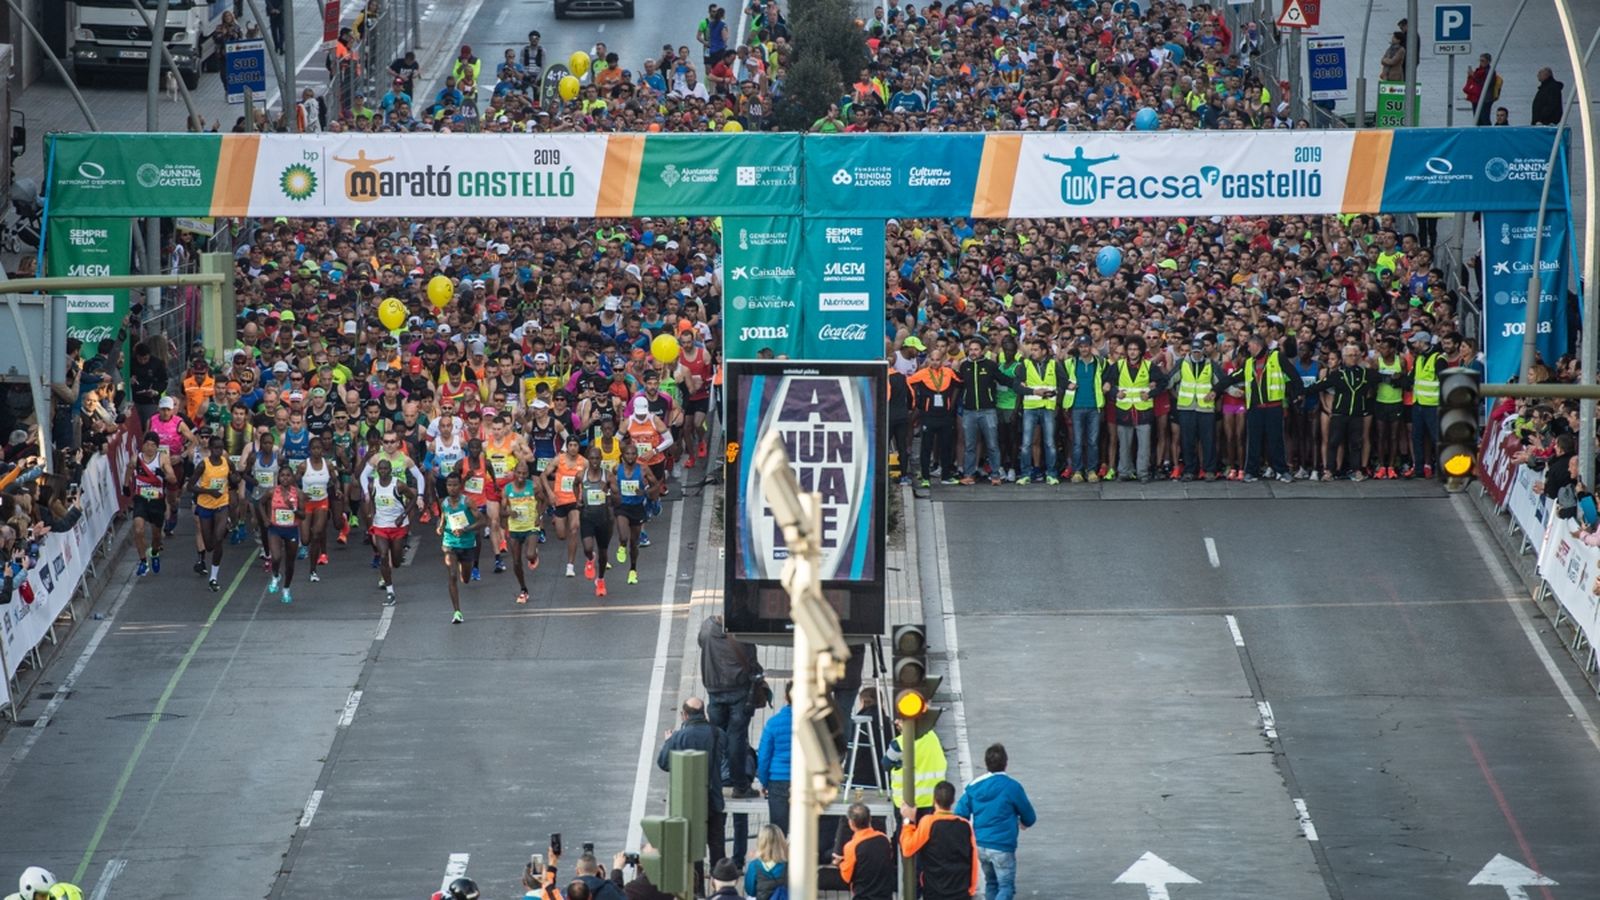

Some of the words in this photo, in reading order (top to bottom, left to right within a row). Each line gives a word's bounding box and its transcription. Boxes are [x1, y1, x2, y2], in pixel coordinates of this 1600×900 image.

[1442, 10, 1464, 37] P
[1315, 53, 1338, 64] SUB
[303, 149, 319, 161] bp
[534, 149, 560, 165] 2019
[1294, 147, 1322, 163] 2019
[160, 169, 201, 178] RUNNING
[854, 172, 892, 180] TRINIDAD
[909, 167, 943, 176] Cultura
[350, 165, 451, 198] marató
[457, 166, 574, 198] CASTELLÓ
[854, 179, 892, 187] ALFONSO
[908, 175, 952, 186] Esfuerzo
[1065, 175, 1097, 200] 10K
[1221, 169, 1322, 198] castelló
[69, 229, 108, 238] SEMPRE
[825, 227, 863, 236] SEMPRE
[69, 237, 96, 245] TEUA
[823, 262, 865, 275] SALERA
[1512, 260, 1560, 271] CaixBank
[750, 266, 796, 277] CaixaBank
[748, 300, 796, 309] BAVIERA
[777, 379, 852, 422] A
